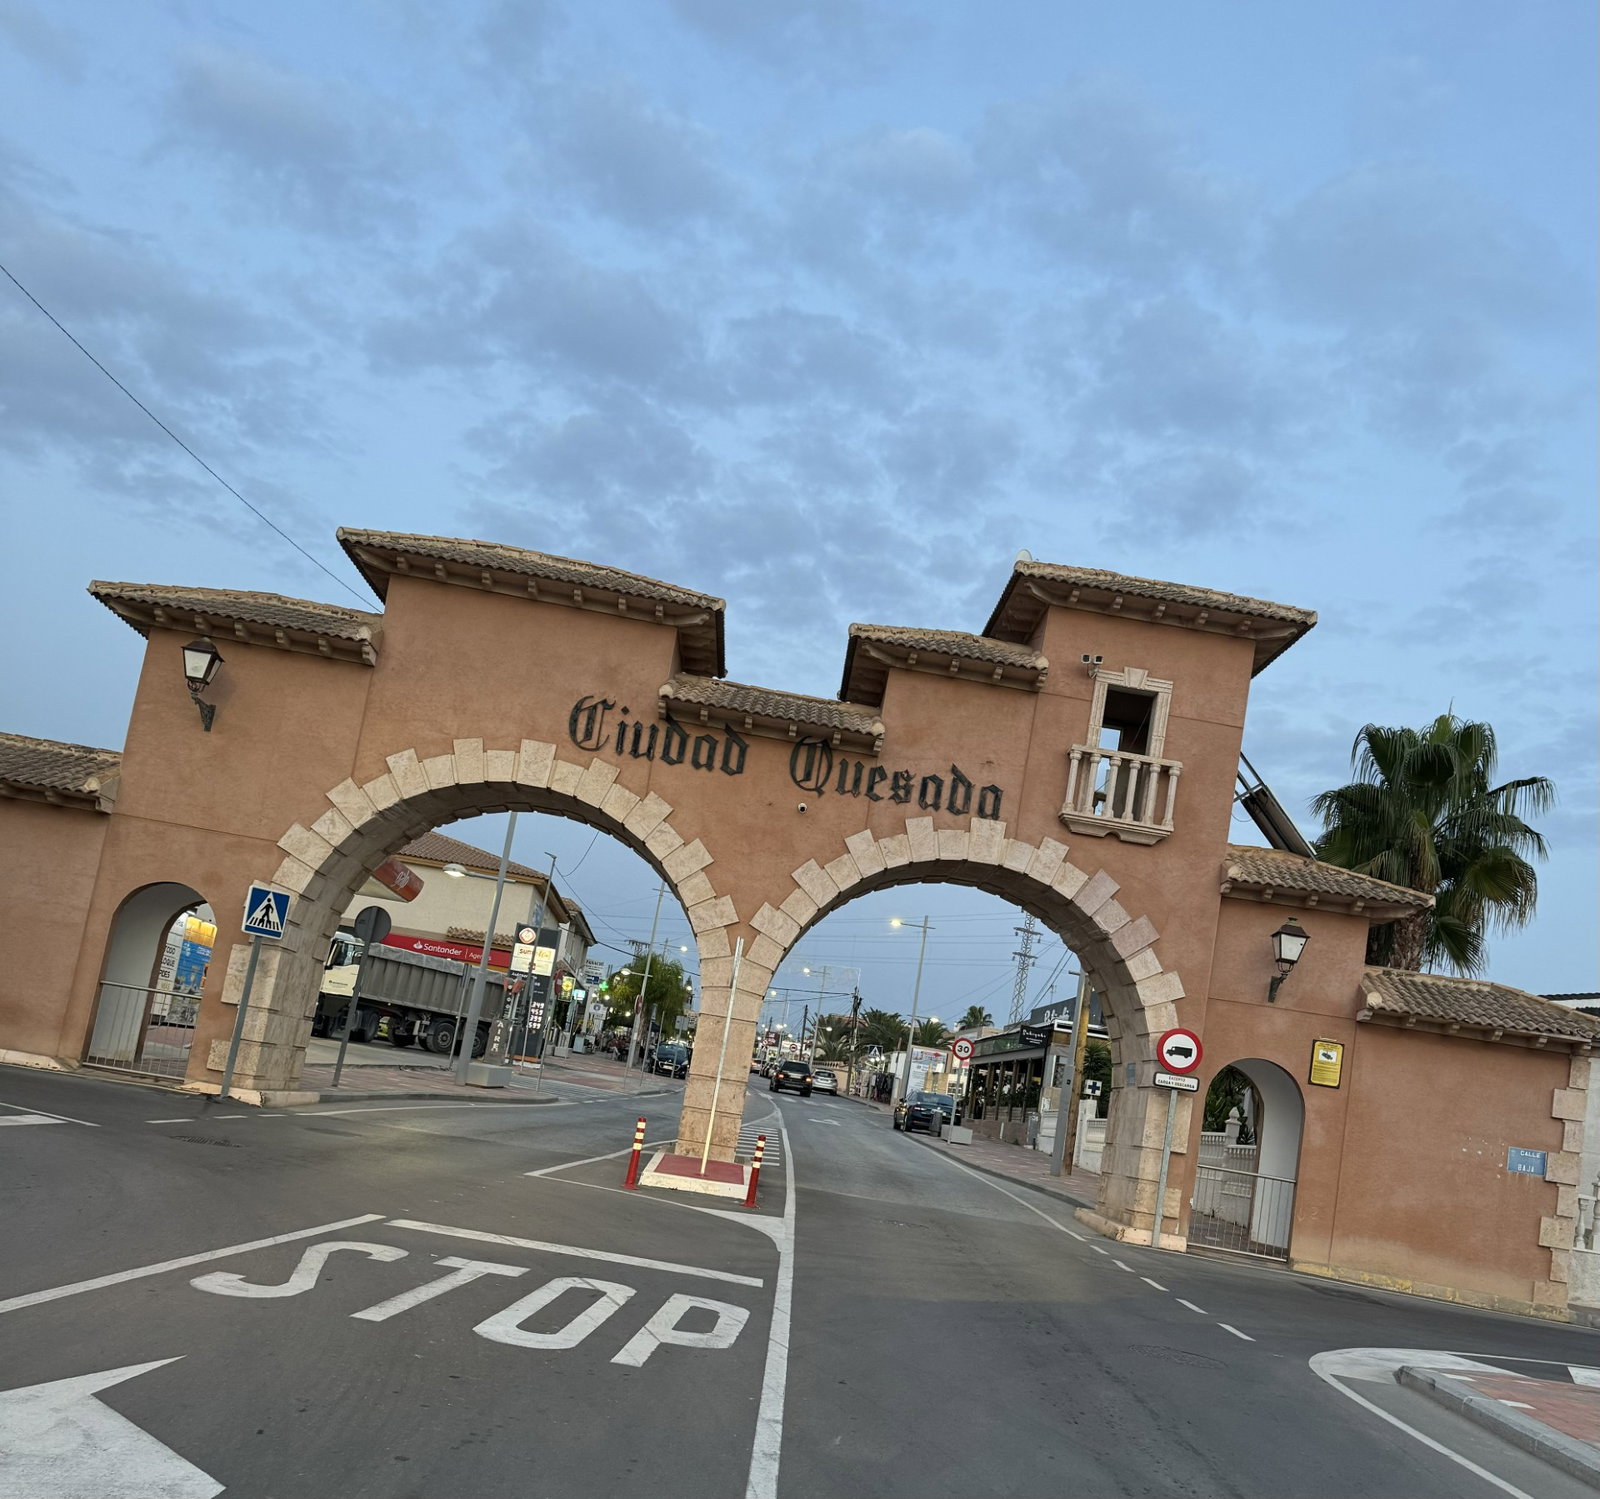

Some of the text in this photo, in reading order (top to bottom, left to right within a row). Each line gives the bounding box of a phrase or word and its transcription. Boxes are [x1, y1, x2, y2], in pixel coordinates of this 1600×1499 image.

[568, 694, 1002, 820] Ciudad Quesada
[423, 943, 461, 956] Santander
[957, 1045, 970, 1054] 30
[1520, 1150, 1541, 1159] CALLE
[1517, 1163, 1535, 1173] BAJA
[190, 1240, 751, 1367] STOP
